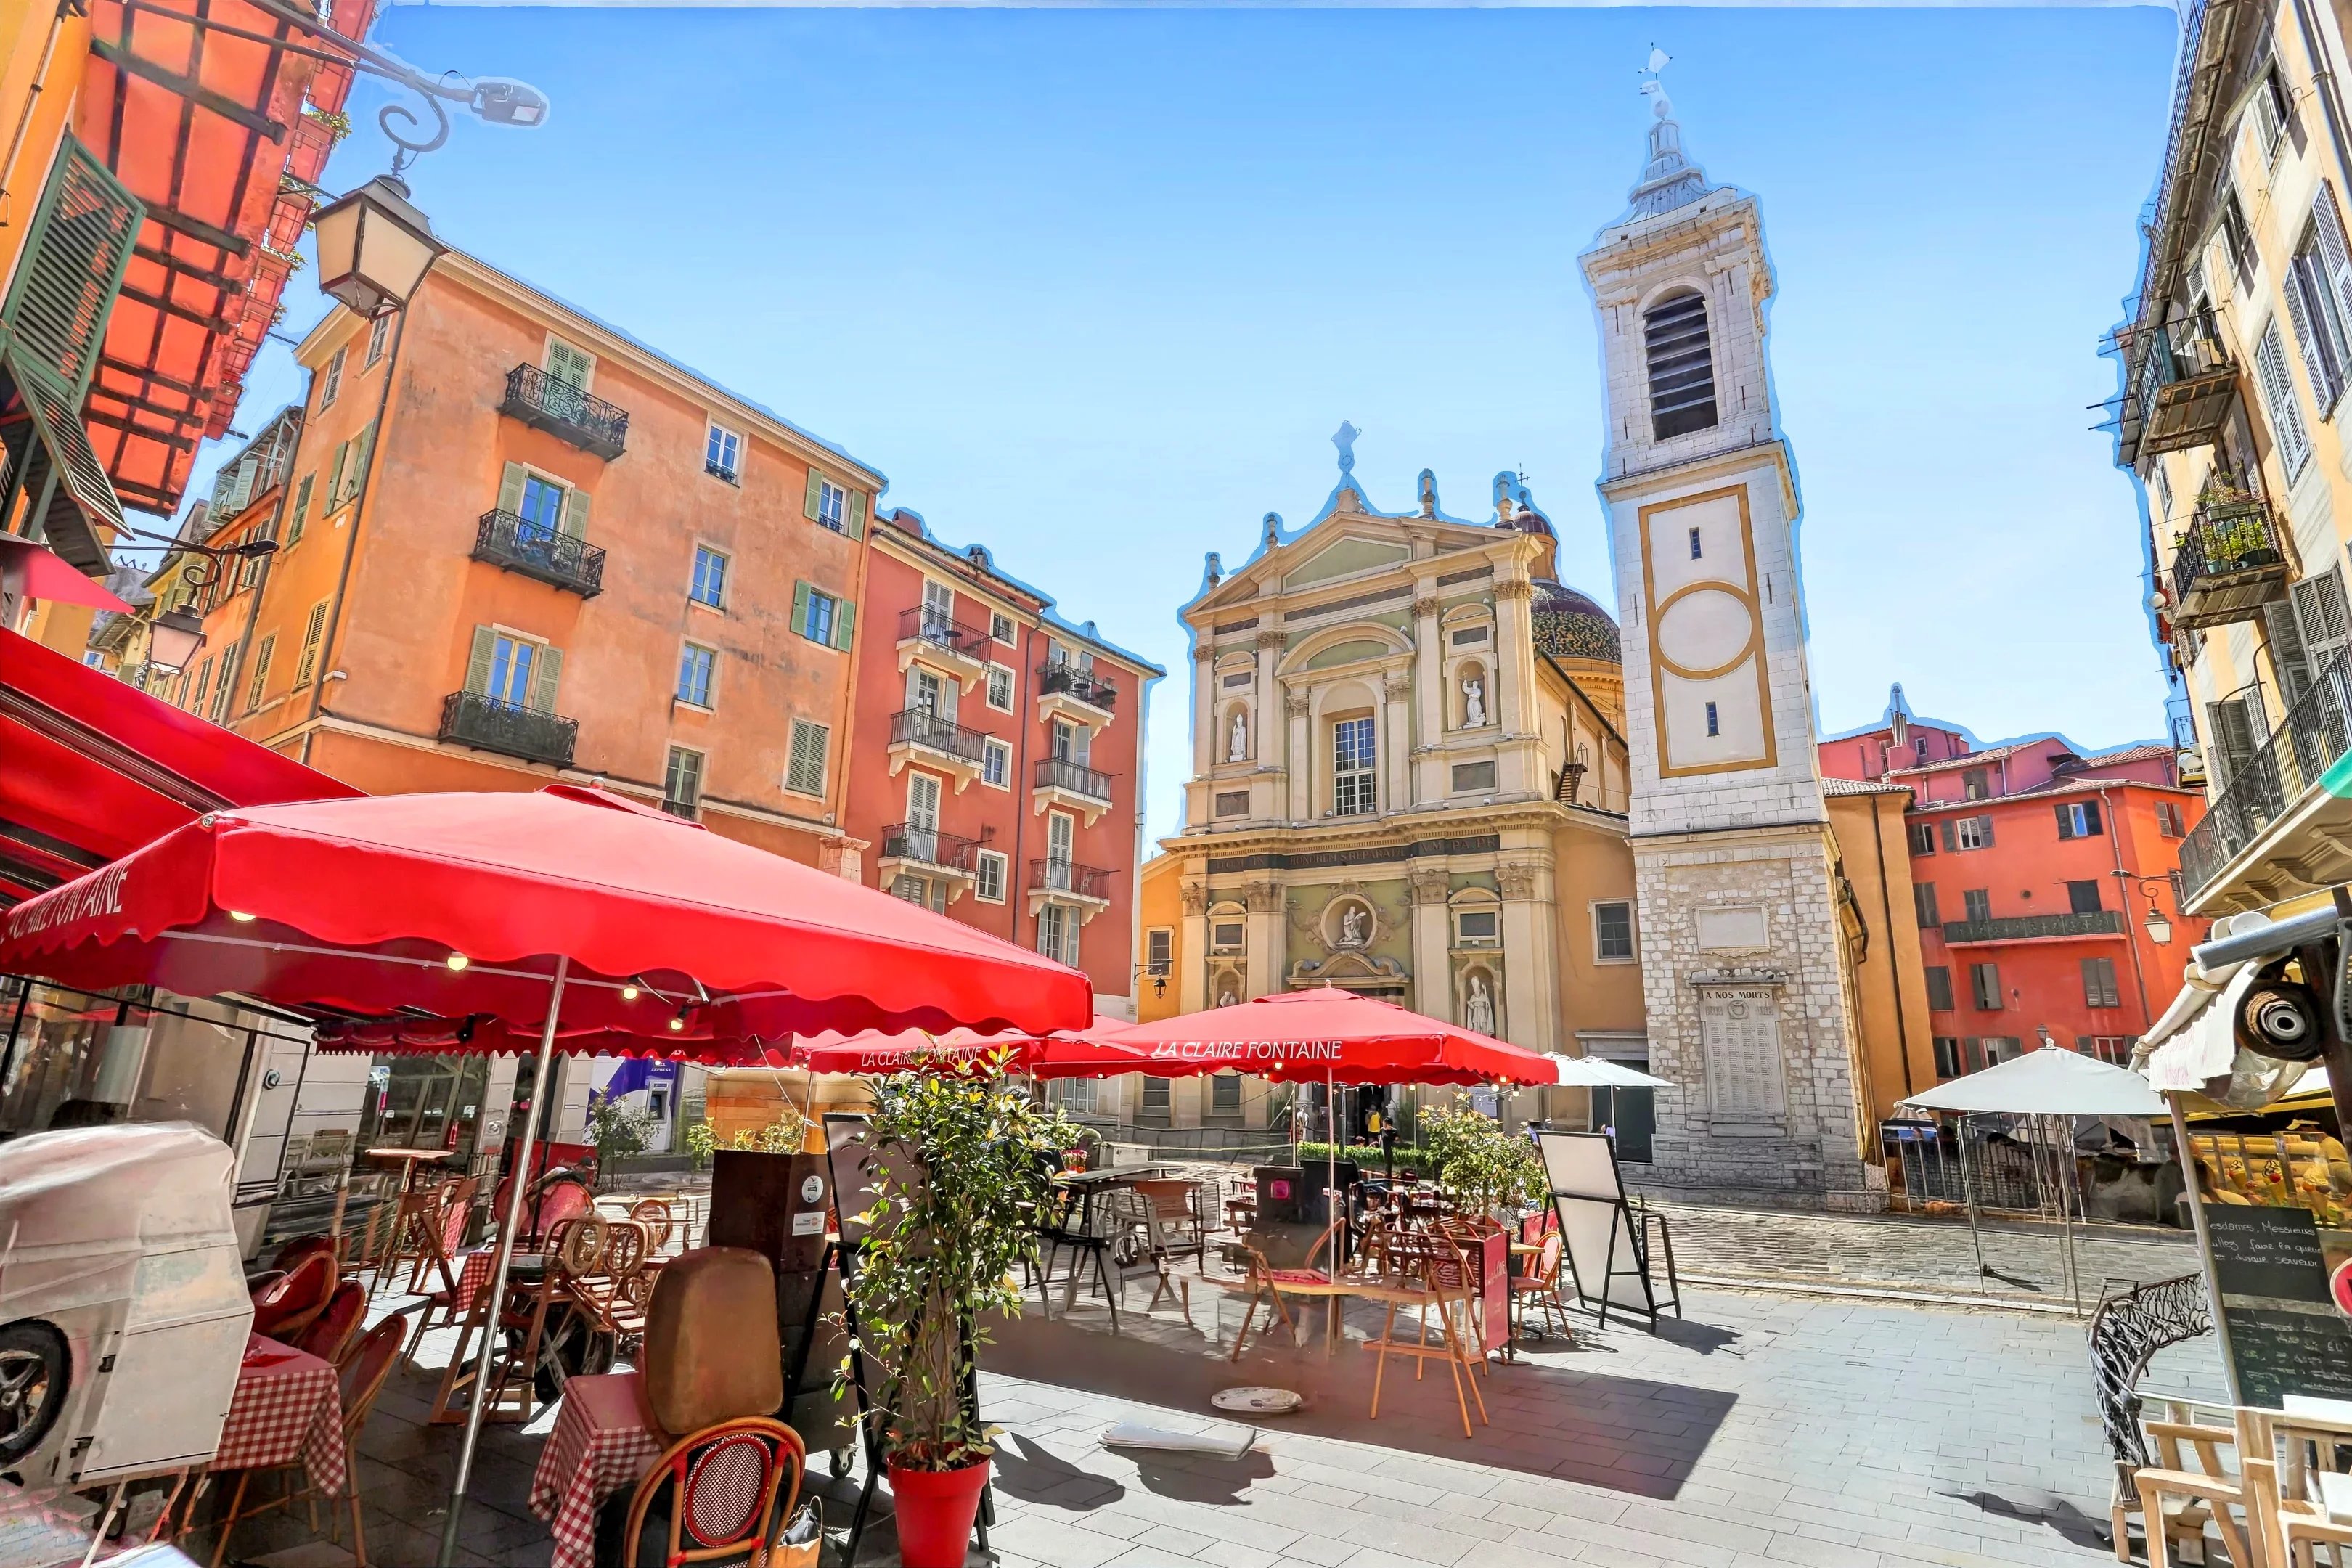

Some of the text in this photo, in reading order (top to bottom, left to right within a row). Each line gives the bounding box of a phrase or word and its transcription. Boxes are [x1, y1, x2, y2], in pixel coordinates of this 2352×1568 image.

[47, 858, 134, 928] FONTAINE
[861, 1052, 875, 1067] LA
[1151, 1040, 1342, 1060] LA CLAIRE FONTAINE
